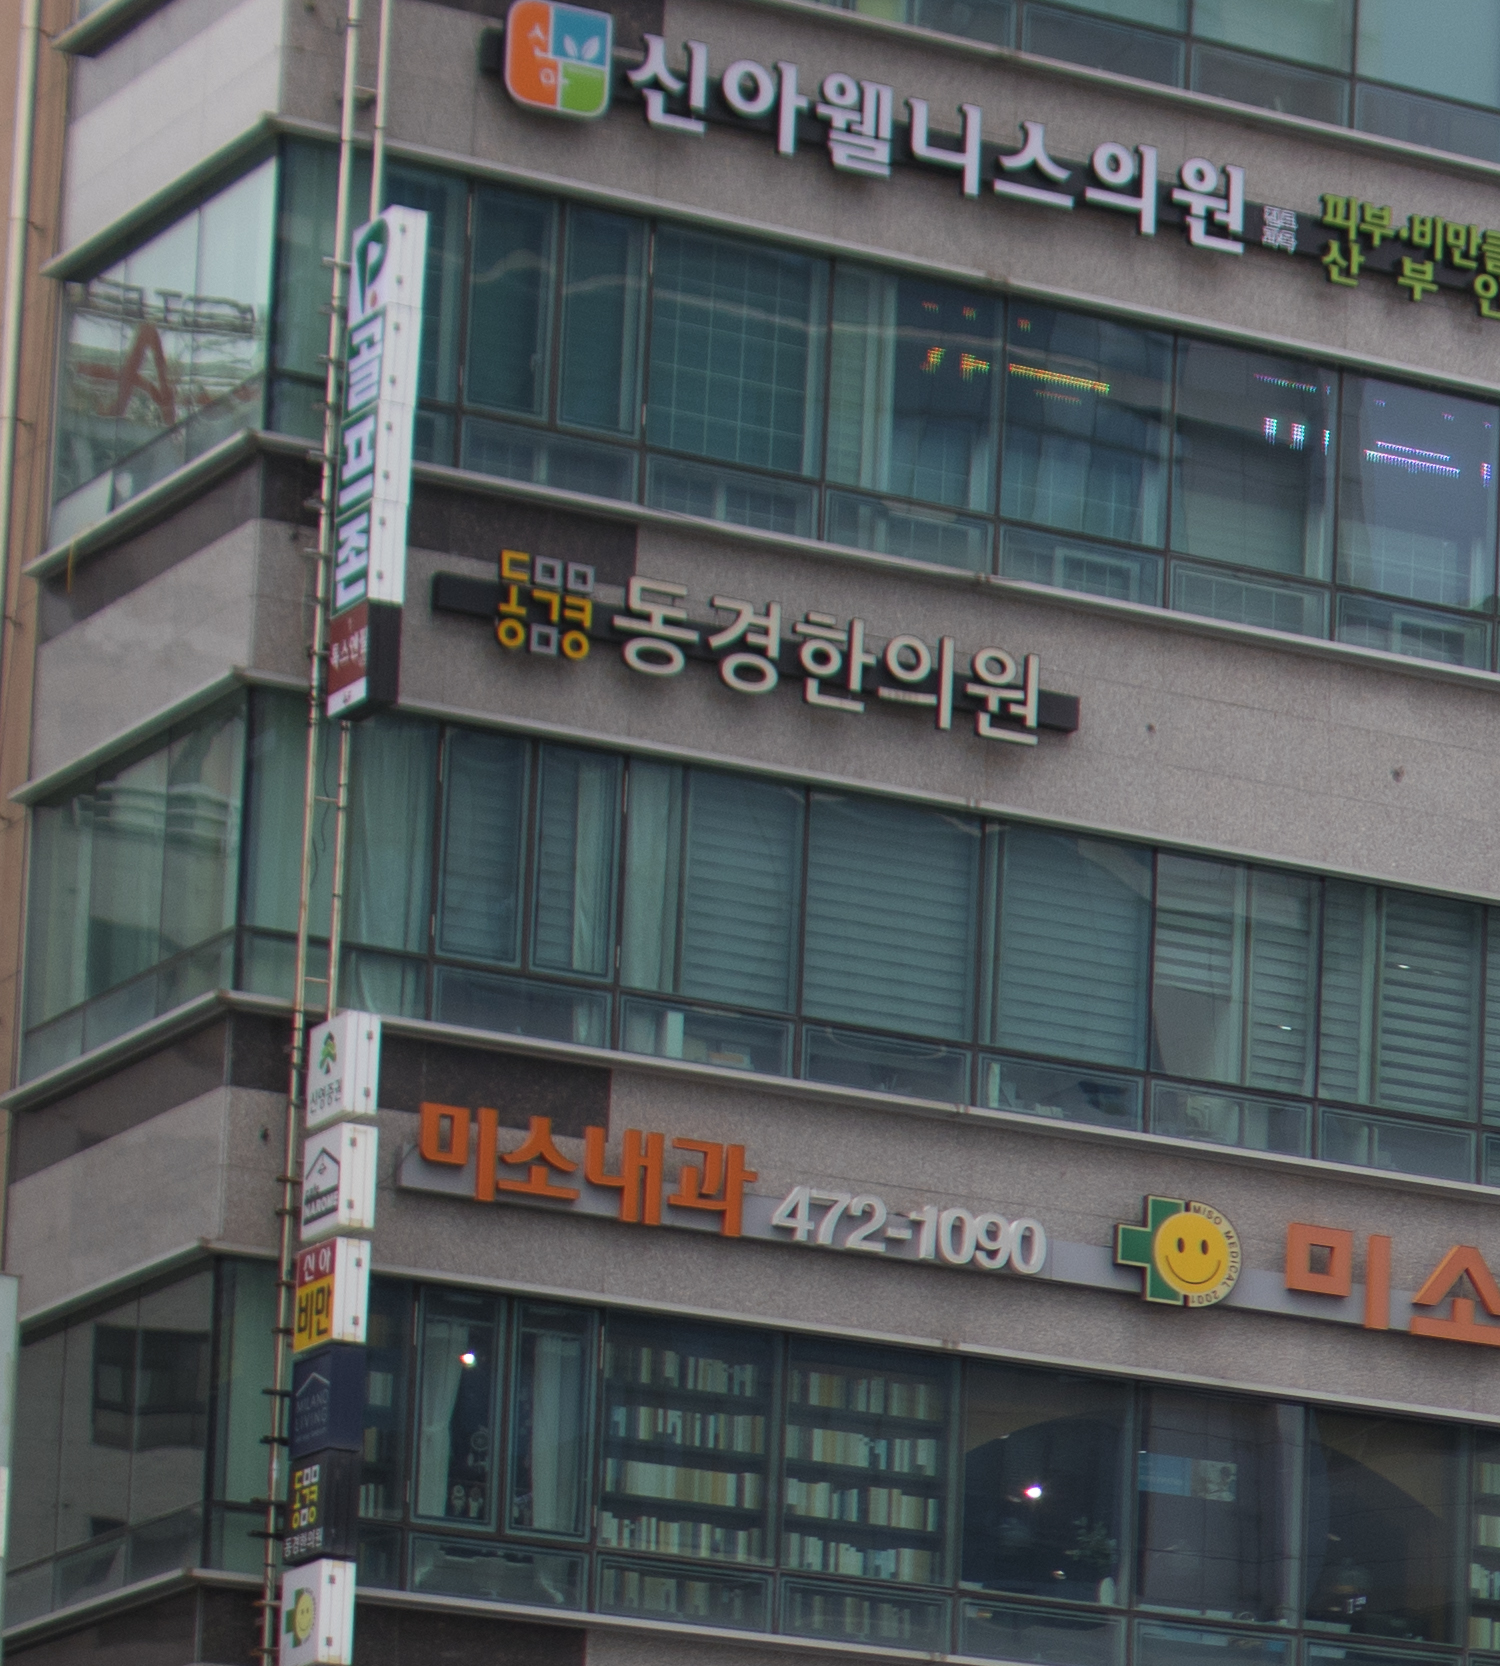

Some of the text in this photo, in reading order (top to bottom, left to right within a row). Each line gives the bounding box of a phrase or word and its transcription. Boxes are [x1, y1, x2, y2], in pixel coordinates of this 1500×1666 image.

[627, 31, 1246, 256] 신아웰니스의원
[612, 575, 1040, 746] 동경한의원
[309, 1077, 343, 1115] 신영증권
[418, 1101, 1048, 1276] 미소내과 472-1090
[296, 1283, 333, 1340] 비만
